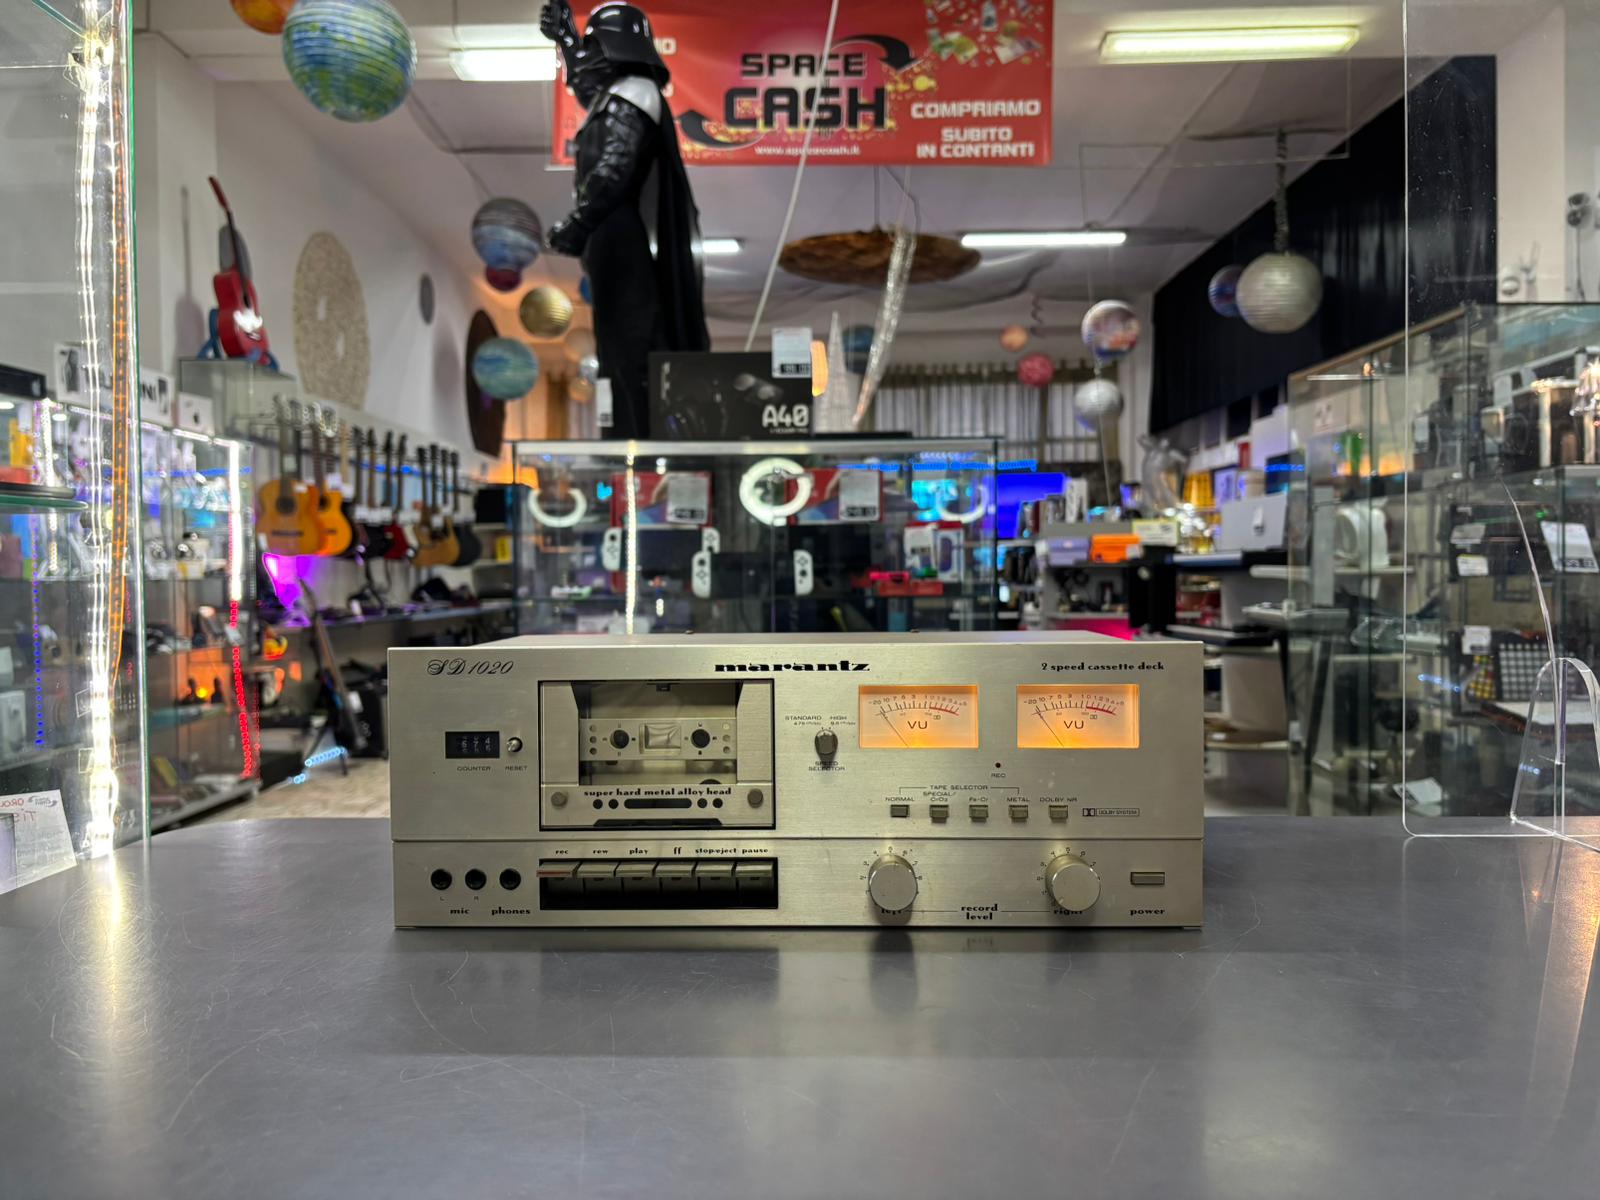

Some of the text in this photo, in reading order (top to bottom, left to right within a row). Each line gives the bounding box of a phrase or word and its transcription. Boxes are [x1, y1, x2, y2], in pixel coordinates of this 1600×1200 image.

[741, 53, 864, 77] SPACE
[725, 87, 886, 128] CASH
[911, 100, 1041, 119] COMPRIAMO
[941, 126, 1013, 142] SUBITO
[916, 142, 1035, 158] IN CONTANTI
[762, 404, 809, 428] A40
[714, 660, 870, 672] marantz
[1042, 662, 1048, 670] 2
[1050, 662, 1085, 672] speed
[1138, 662, 1165, 670] deck
[907, 720, 928, 730] VU
[1064, 720, 1084, 730] VU
[584, 788, 732, 798] super hard metal alloy head
[629, 848, 648, 857] play
[492, 906, 530, 916] phones
[960, 903, 998, 912] record
[1130, 908, 1166, 916] power
[966, 912, 994, 920] level
